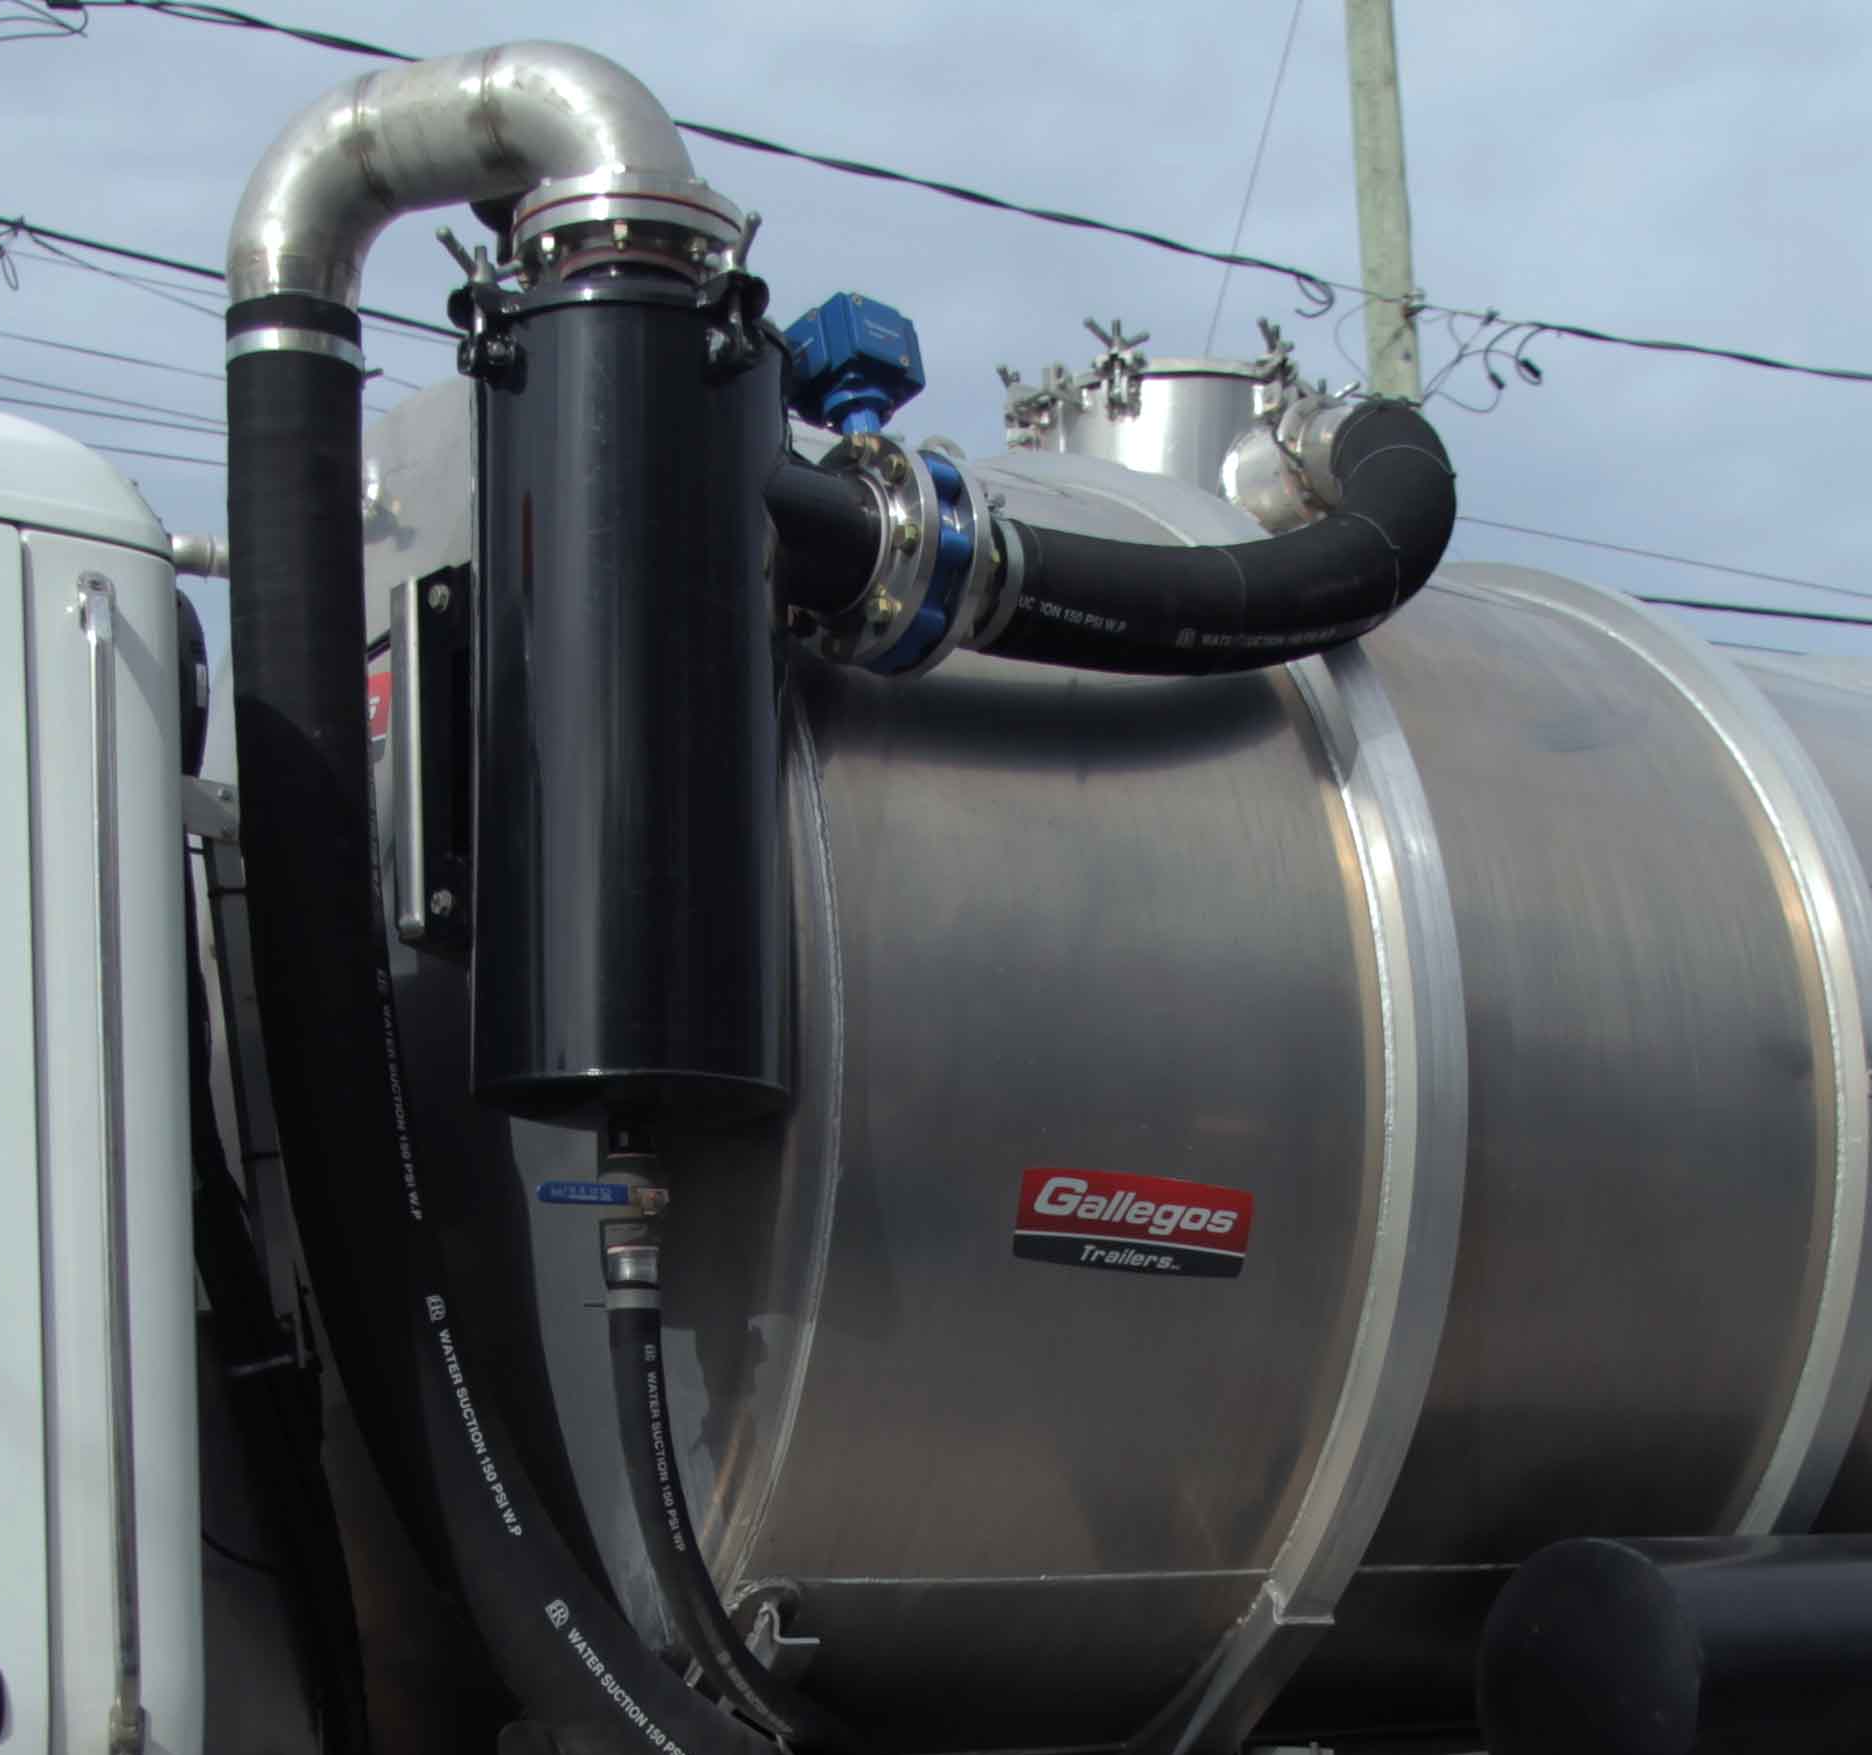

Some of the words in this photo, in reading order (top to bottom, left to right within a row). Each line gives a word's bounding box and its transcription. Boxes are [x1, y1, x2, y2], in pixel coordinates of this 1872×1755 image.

[1032, 1176, 1239, 1236] Gallegos
[1079, 1244, 1175, 1271] Trailers
[438, 1328, 464, 1386] WATER
[455, 1385, 488, 1456] SUCTION
[479, 1455, 499, 1484] 150
[490, 1482, 511, 1510] PSI
[646, 1370, 665, 1421] WATER
[650, 1421, 671, 1483] SUCTION
[567, 1627, 607, 1679] WATER
[598, 1672, 650, 1728] SUCTION
[643, 1722, 668, 1747] 150
